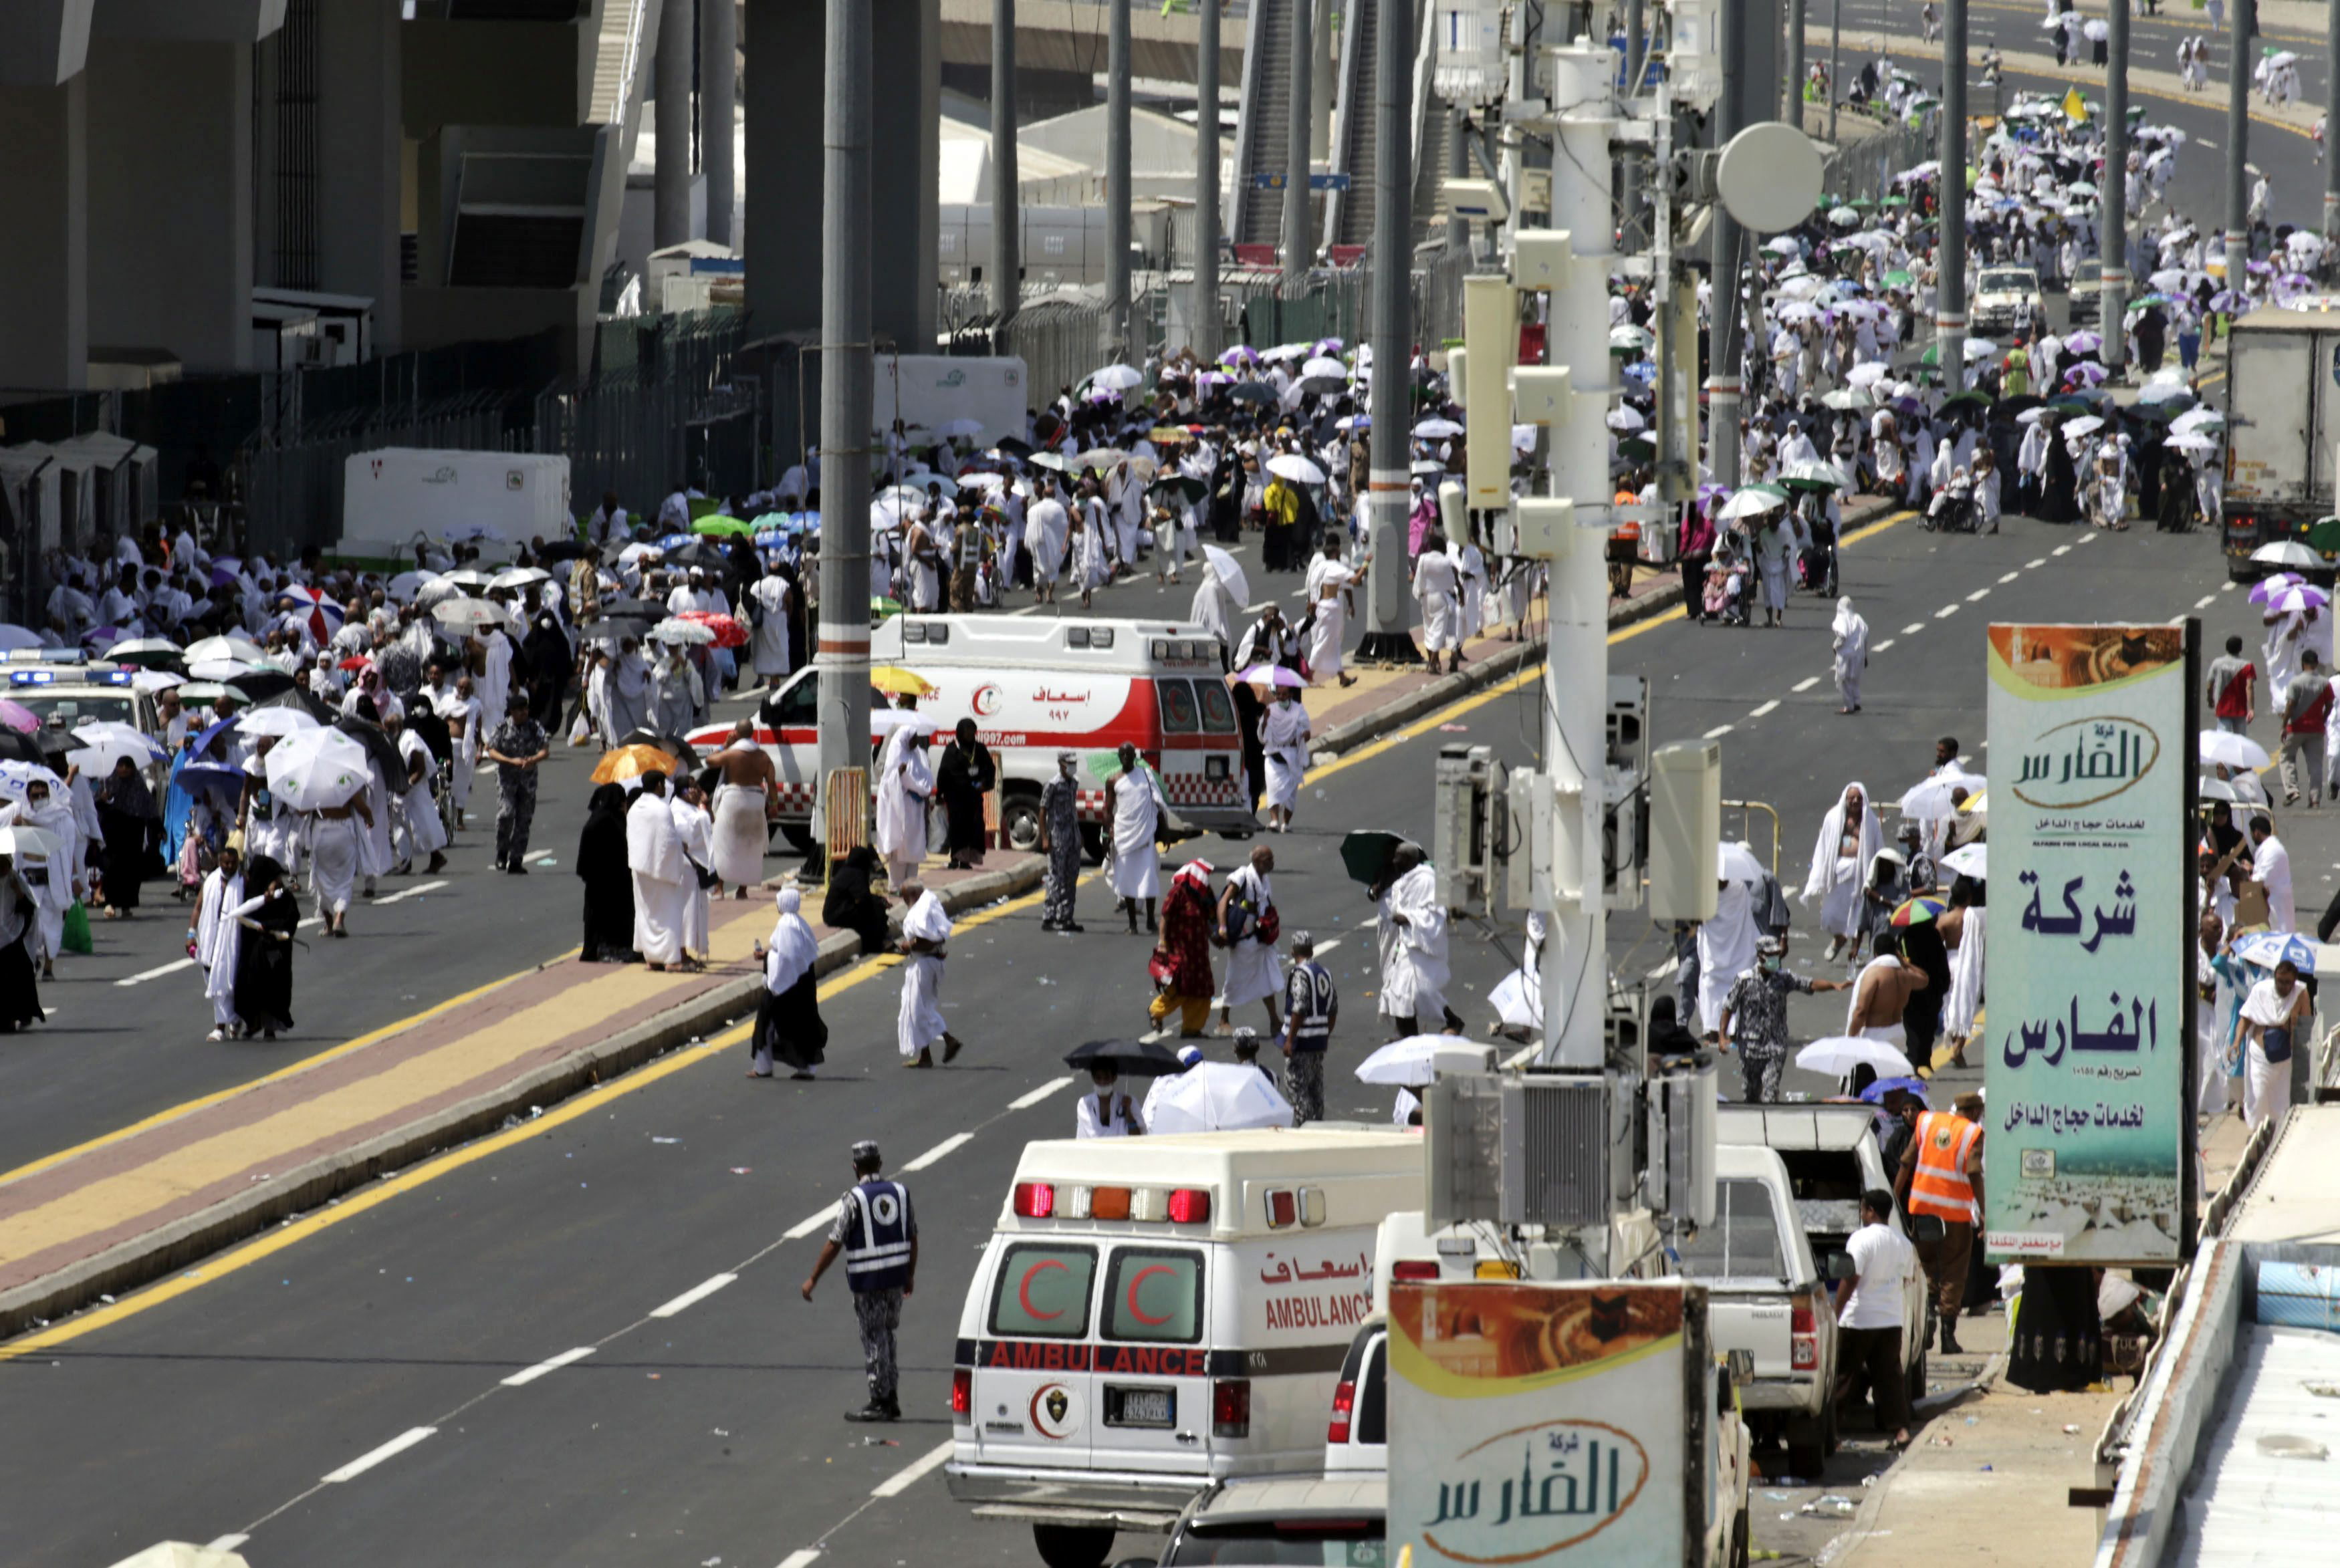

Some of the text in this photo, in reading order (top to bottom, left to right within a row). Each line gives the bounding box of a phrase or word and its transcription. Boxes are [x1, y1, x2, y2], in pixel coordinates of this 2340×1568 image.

[1032, 684, 1091, 706] إسعاف
[1049, 709, 1069, 721] ٩٩٧
[2094, 724, 2115, 739] شركة
[2012, 728, 2140, 785] الفارس
[2035, 818, 2145, 832] لخدمات حجاج الداخل
[2018, 870, 2136, 953] شركة
[2003, 991, 2157, 1069] الفارس
[2004, 1102, 2144, 1134] لخدمات حجاج الداخل
[989, 1341, 1205, 1377] AMBULANCE
[1548, 1432, 1578, 1454] شركة
[1422, 1440, 1618, 1526] الفارس
